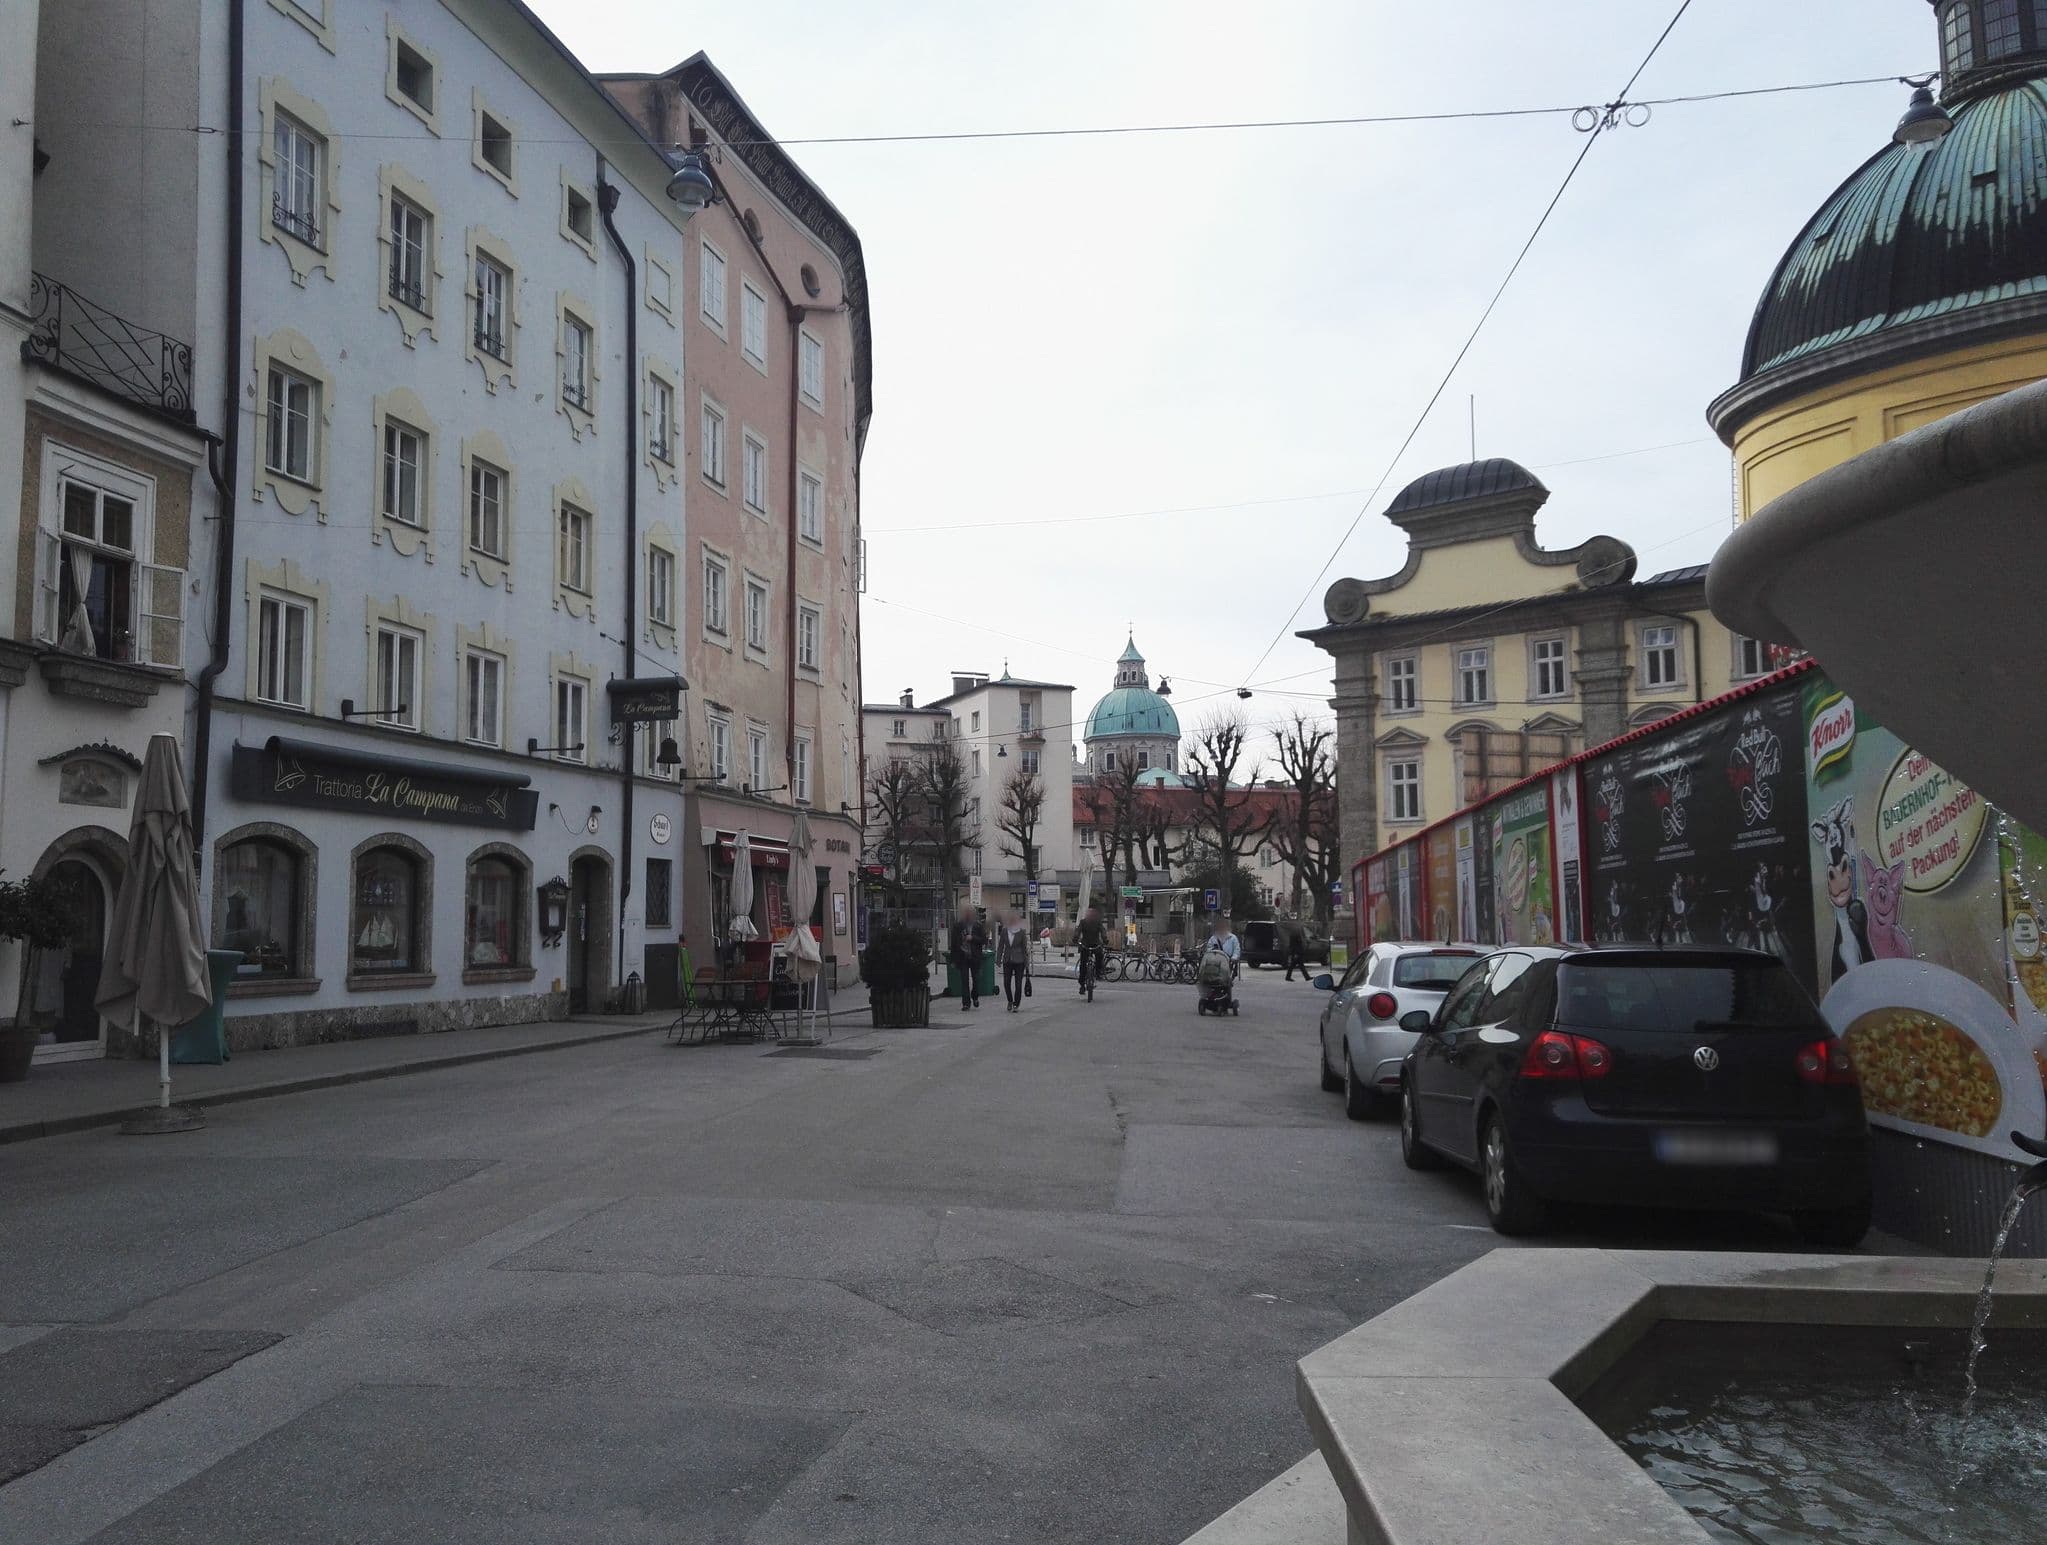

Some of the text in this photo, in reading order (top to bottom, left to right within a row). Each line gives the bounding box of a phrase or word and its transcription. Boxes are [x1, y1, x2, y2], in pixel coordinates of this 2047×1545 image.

[1812, 707, 1853, 758] Knorr
[313, 774, 362, 799] Trattoria
[364, 773, 391, 803] La
[393, 776, 460, 816] Campana
[1889, 788, 1976, 858] auf der nächsten
[1911, 828, 1960, 879] Packung!
